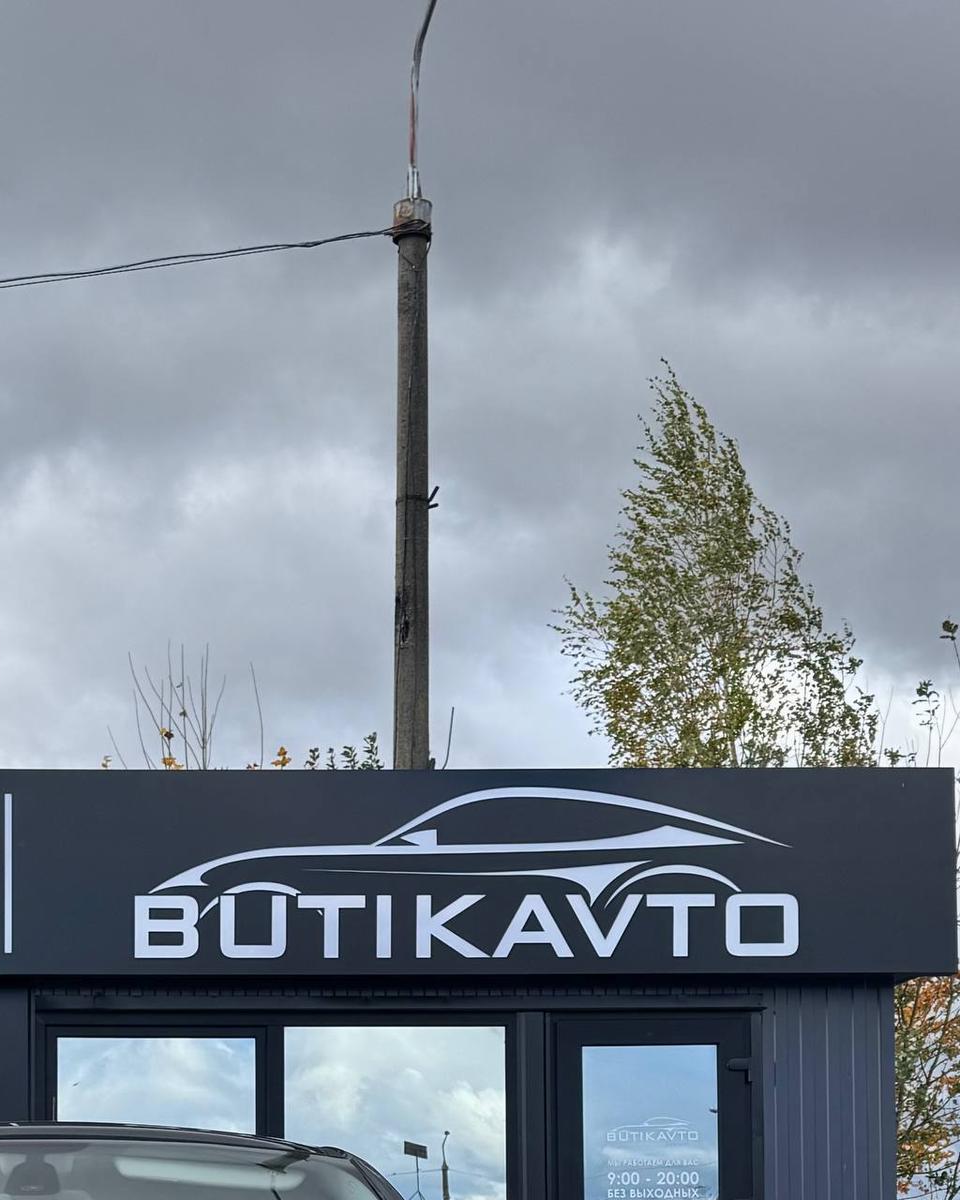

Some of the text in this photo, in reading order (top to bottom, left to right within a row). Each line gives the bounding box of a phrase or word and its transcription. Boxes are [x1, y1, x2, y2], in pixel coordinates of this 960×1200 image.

[134, 892, 799, 959] BUTIKAVTO
[607, 1130, 699, 1142] BUTIKAVTO
[607, 1171, 640, 1186] 9:00
[657, 1171, 700, 1186] 20:00
[607, 1188, 700, 1199] БЕЗ ВЫХОДНЫХ
